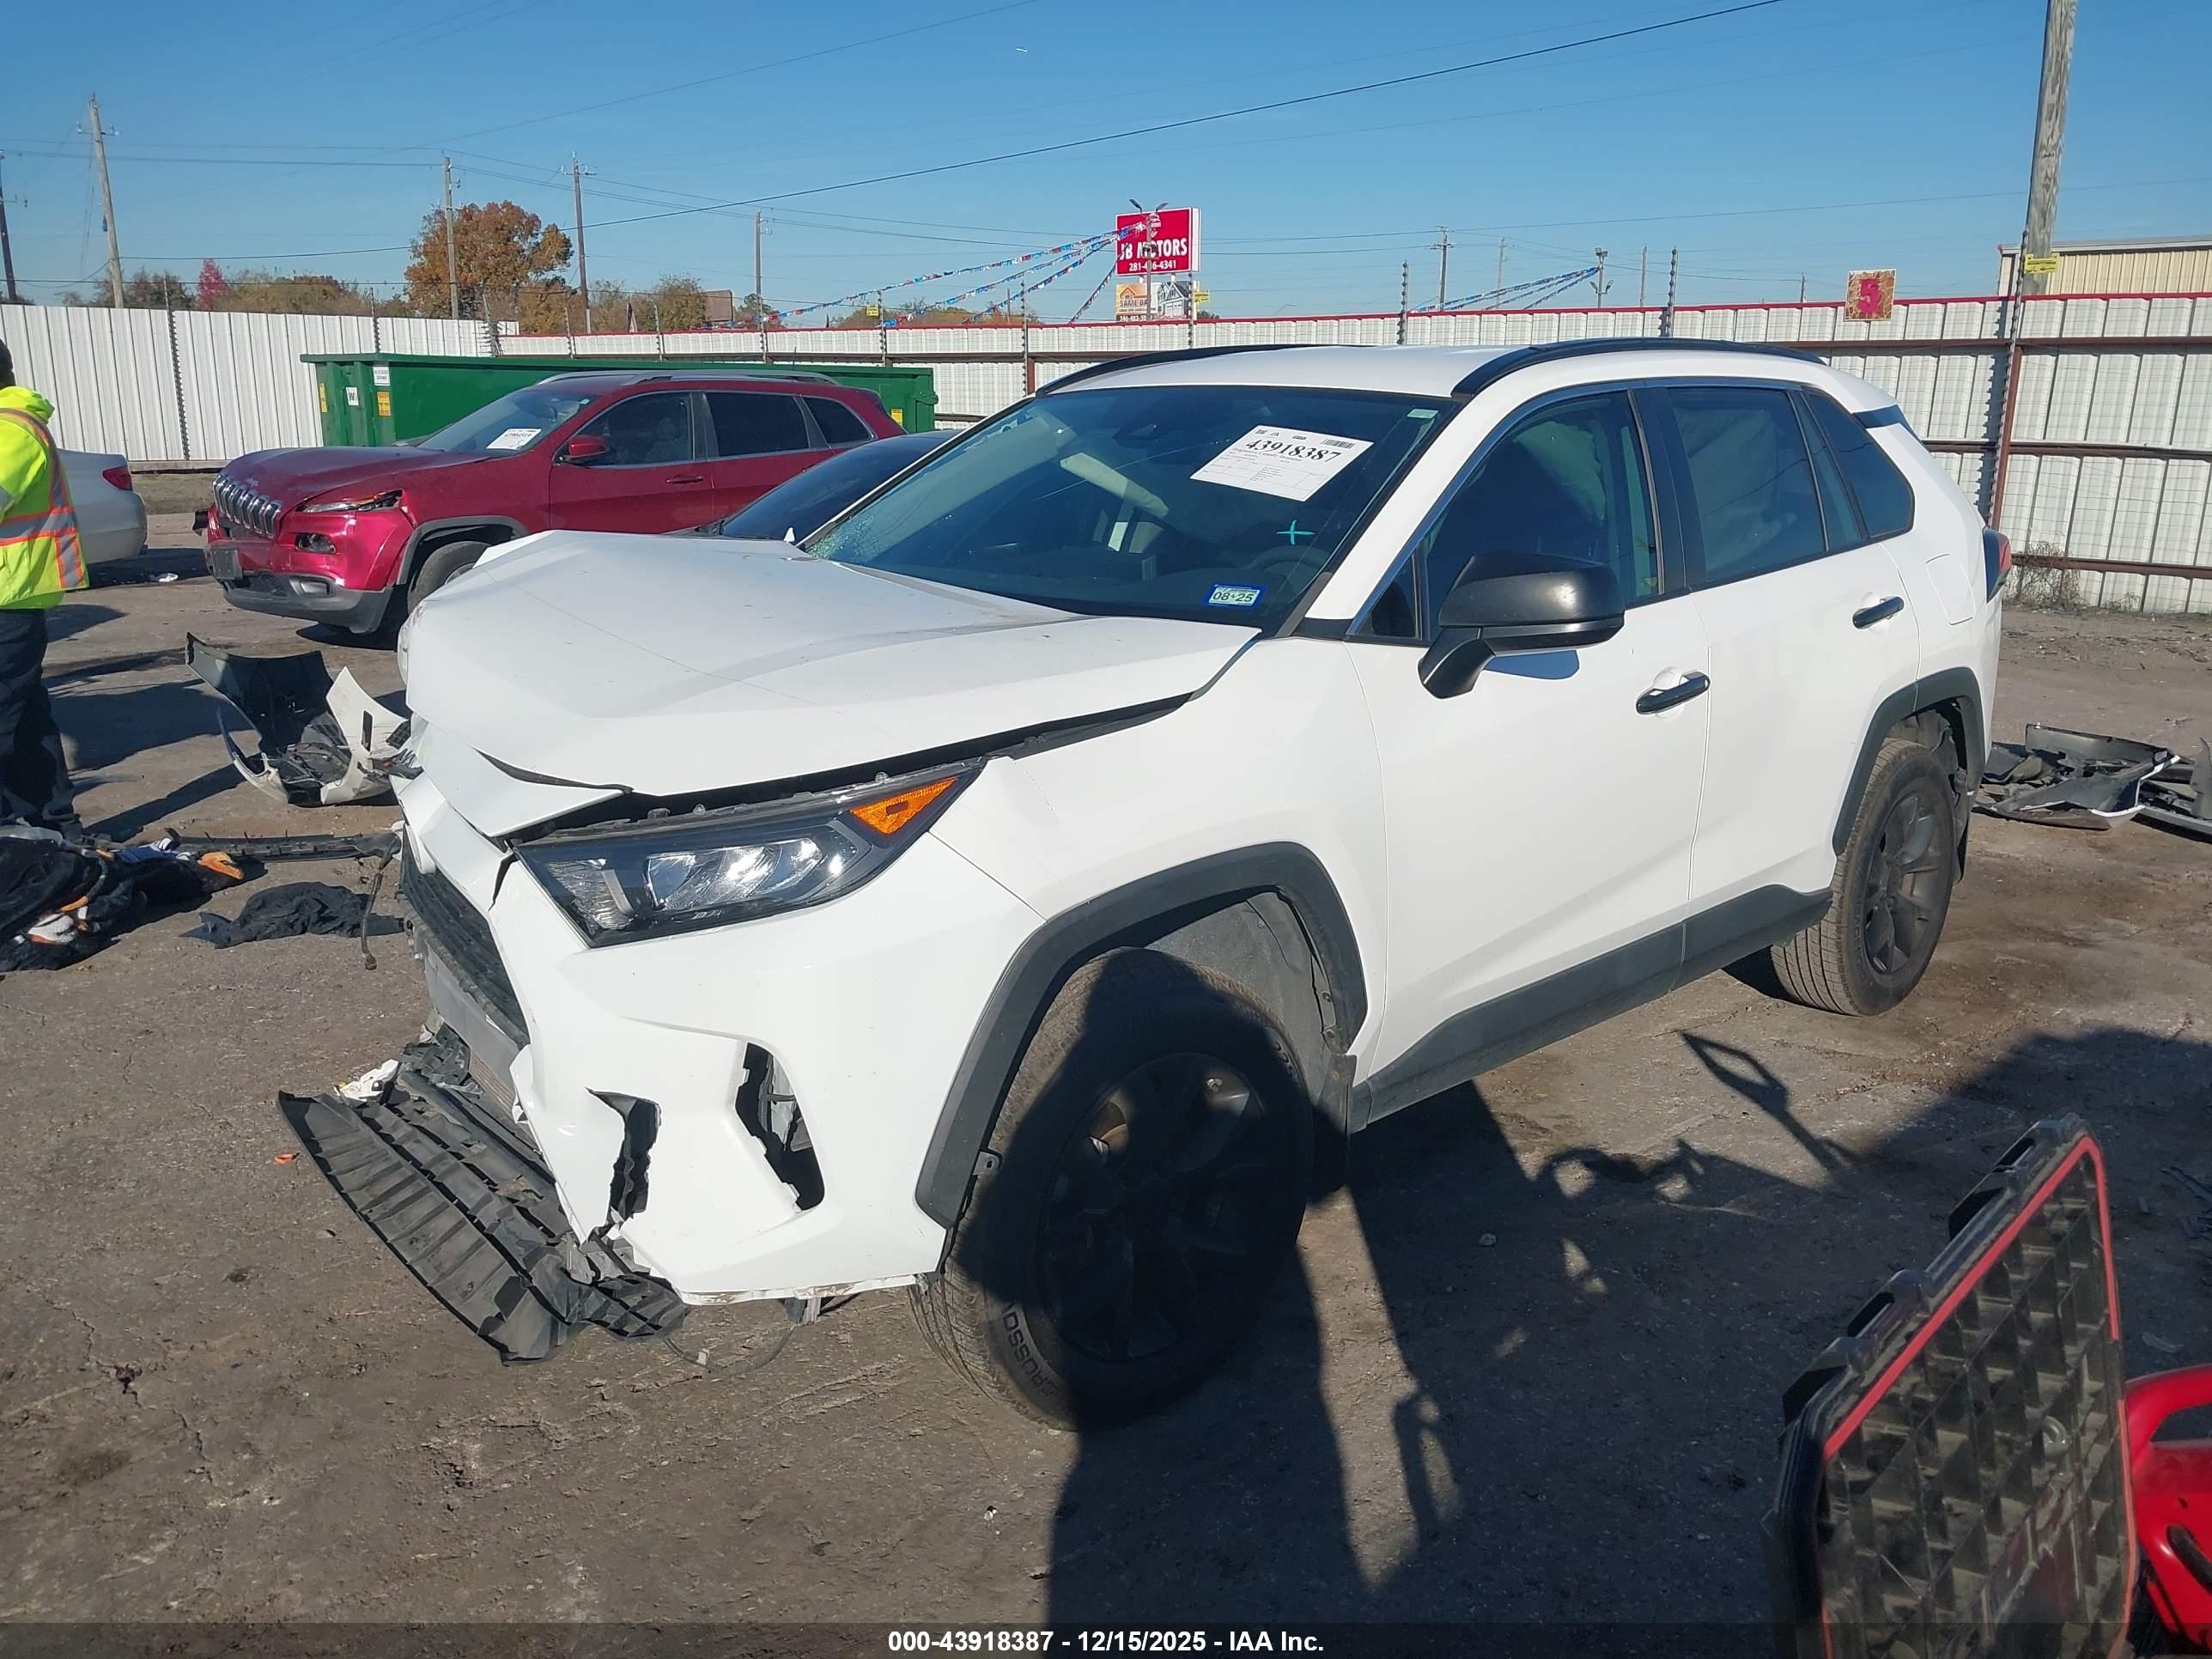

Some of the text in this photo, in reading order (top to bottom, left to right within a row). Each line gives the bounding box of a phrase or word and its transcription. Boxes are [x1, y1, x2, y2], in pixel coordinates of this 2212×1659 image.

[1120, 242, 1133, 260] JB
[1129, 259, 1176, 271] 281-46-4341
[1246, 439, 1342, 463] 43918387
